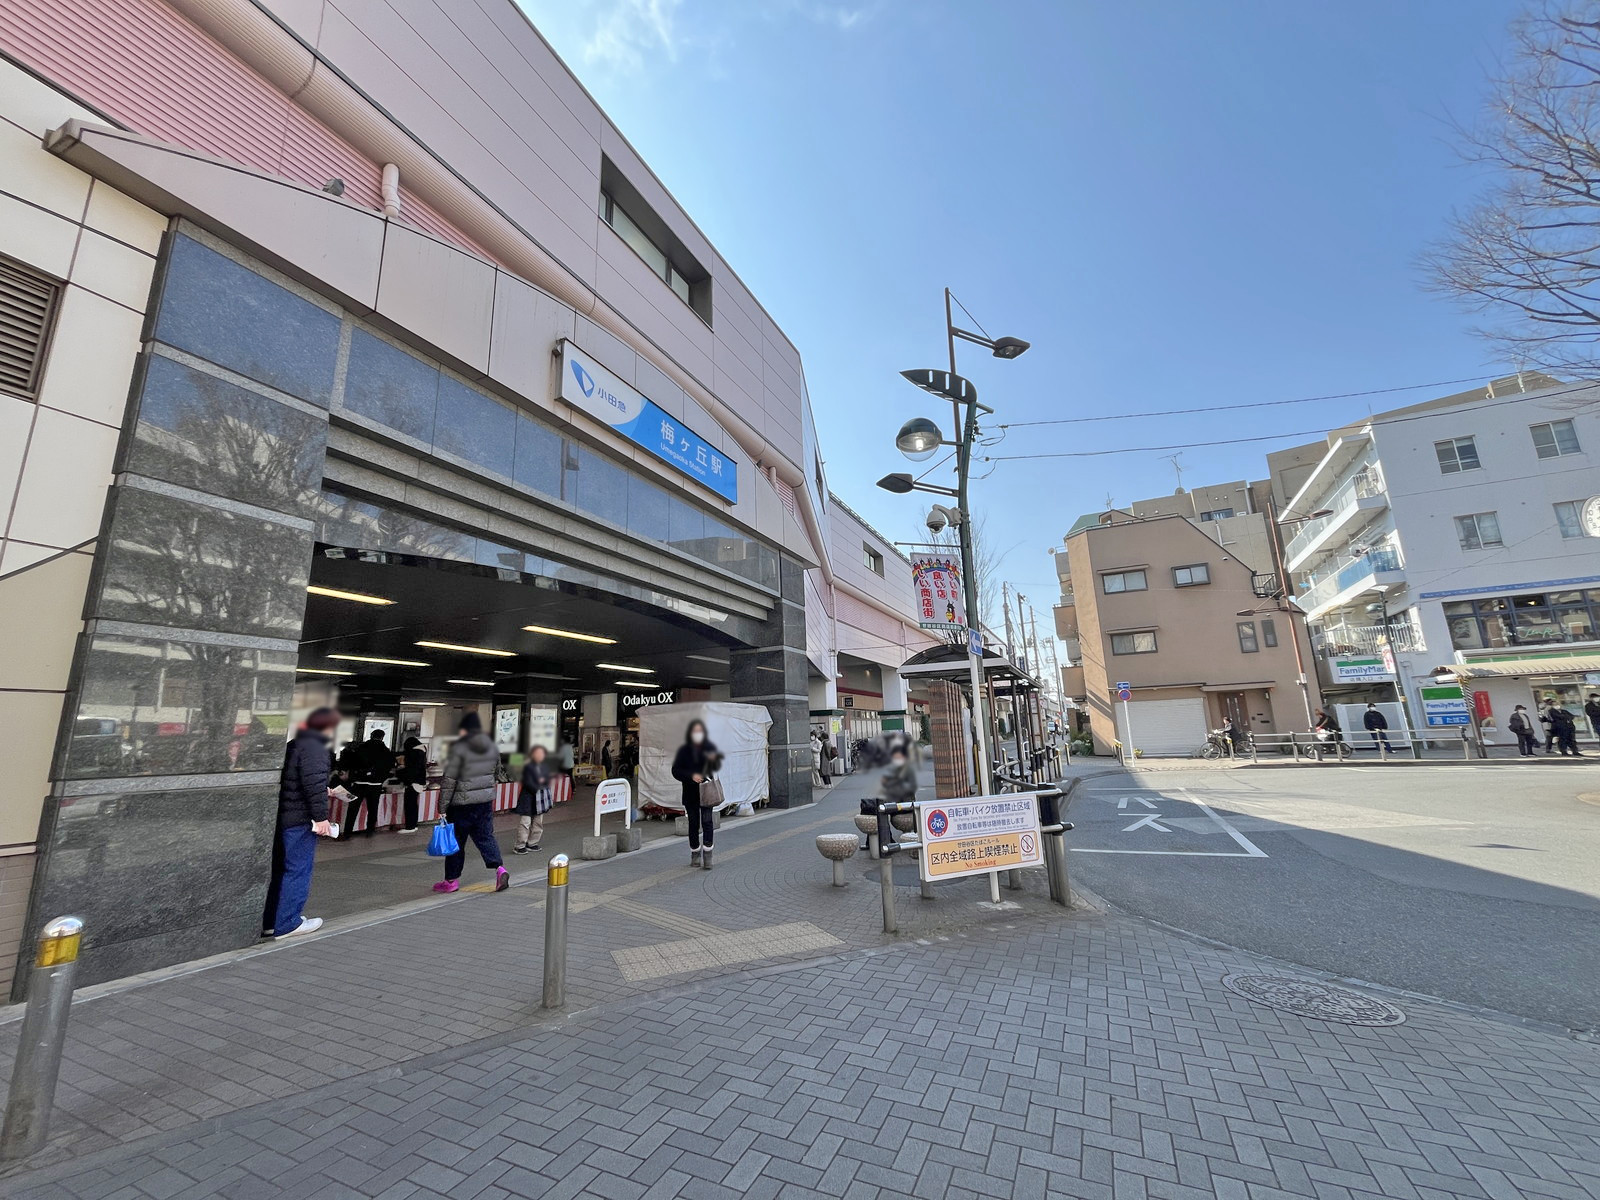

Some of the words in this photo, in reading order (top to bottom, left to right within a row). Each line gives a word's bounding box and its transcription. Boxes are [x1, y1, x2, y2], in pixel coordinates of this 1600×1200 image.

[598, 387, 627, 413] 小田急
[660, 442, 689, 466] Umegaoka
[688, 460, 706, 476] Station
[917, 569, 936, 619] いい商店街
[933, 571, 948, 600] 良い店
[1340, 665, 1385, 674] FamilyMar
[562, 699, 577, 711] OX
[623, 694, 657, 707] Odakyu
[657, 692, 674, 704] OX
[1426, 701, 1465, 709] FamilyMart
[948, 801, 1031, 818] 自転車・バイク放置禁止区域
[1117, 797, 1173, 833] バス
[957, 838, 1000, 848] 世田谷区たばこルール
[931, 843, 1018, 865] 区内全域路上喫煙禁止
[974, 859, 997, 867] Smoking
